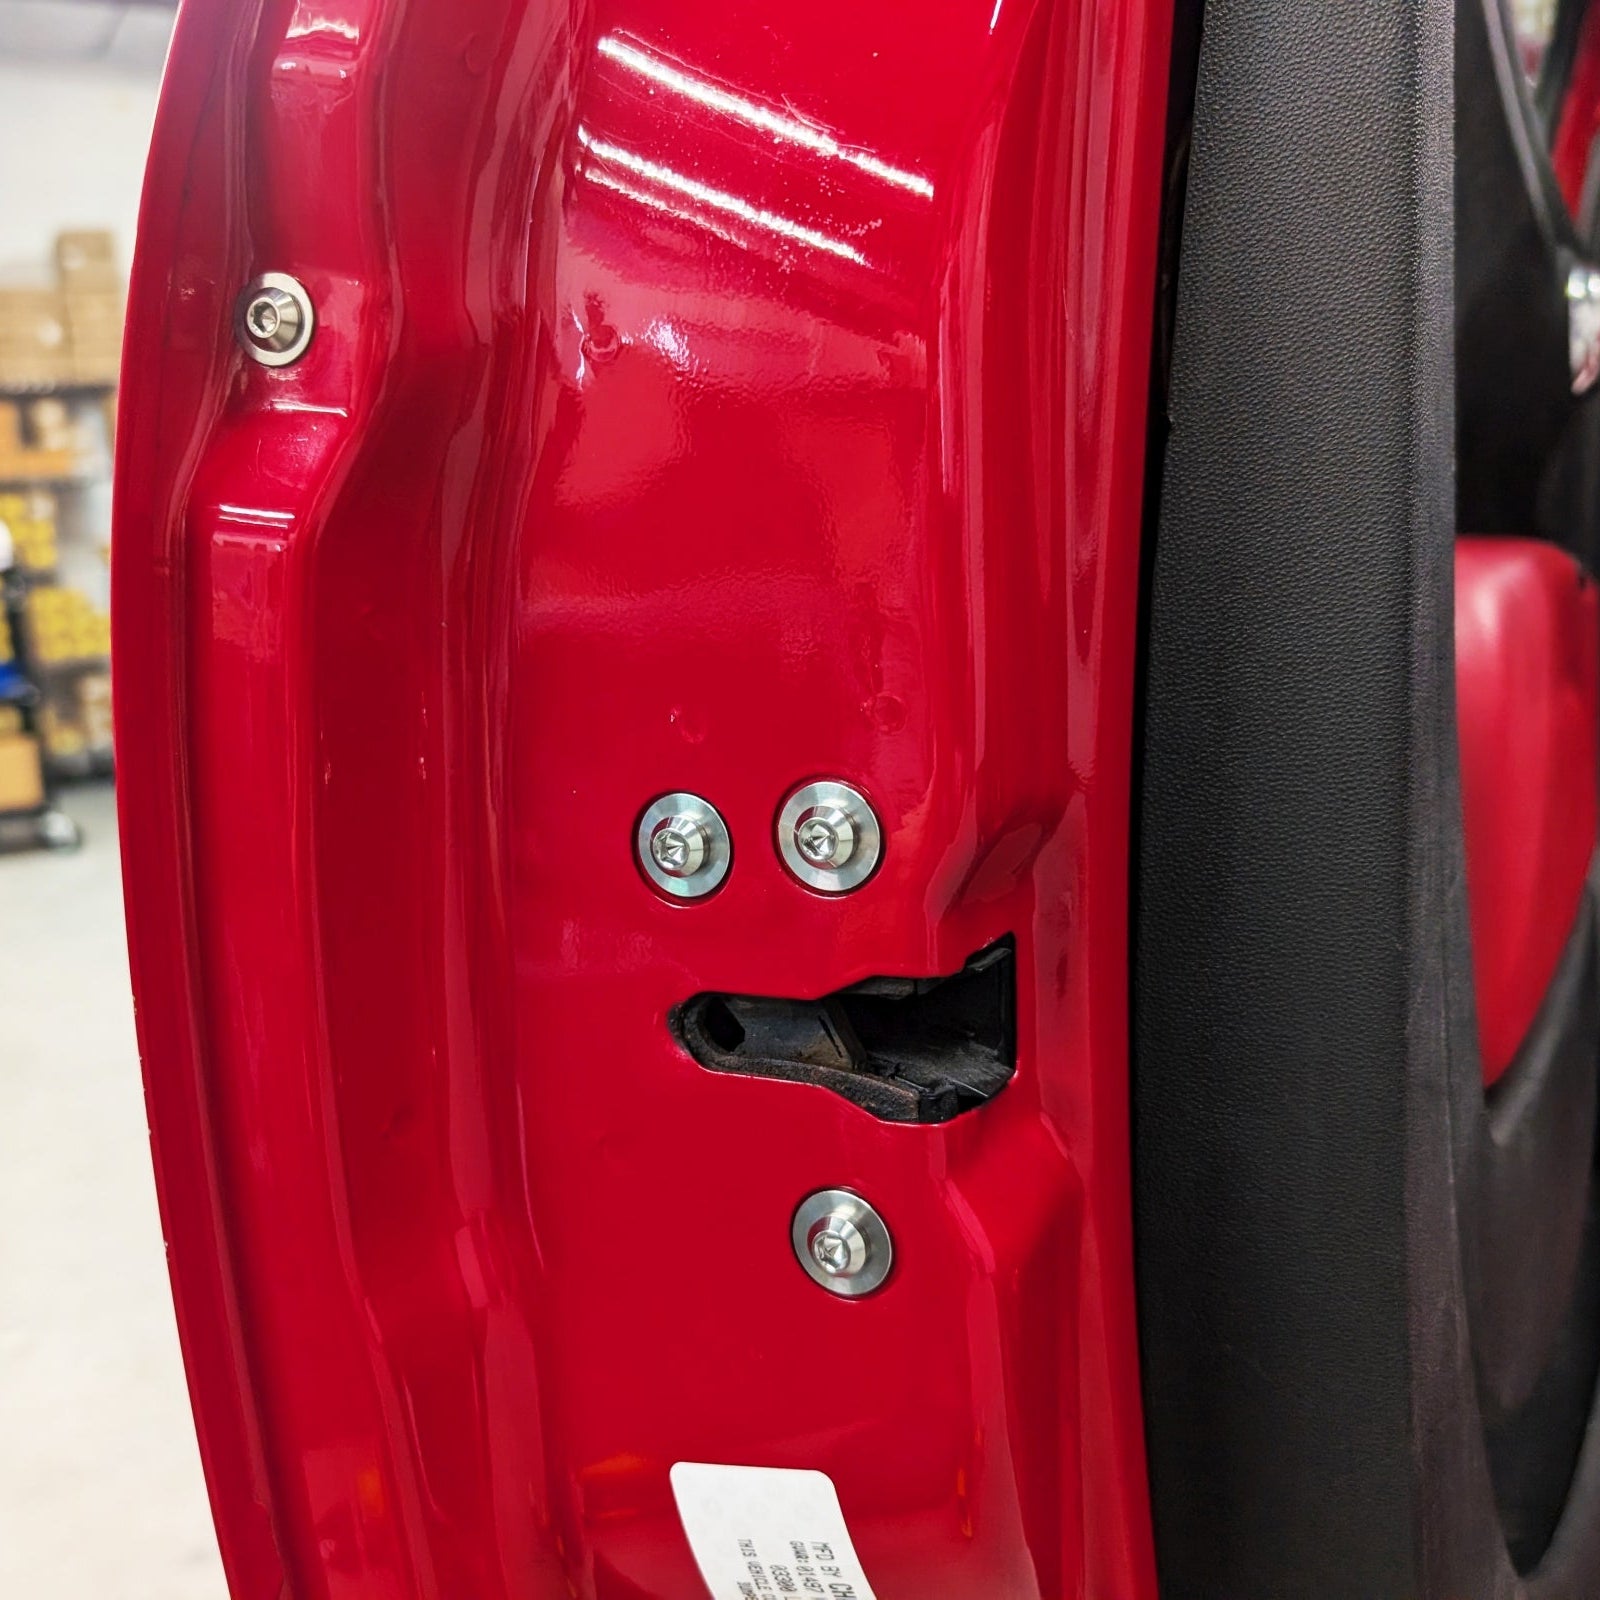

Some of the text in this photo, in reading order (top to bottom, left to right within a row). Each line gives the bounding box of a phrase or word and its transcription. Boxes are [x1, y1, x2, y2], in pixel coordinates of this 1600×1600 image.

[811, 1541, 834, 1560] MFD
[737, 1539, 757, 1557] THIS
[748, 1561, 772, 1591] VEHICLE
[770, 1565, 798, 1592] 03300
[820, 1565, 842, 1578] BY
[796, 1566, 824, 1593] 01497
